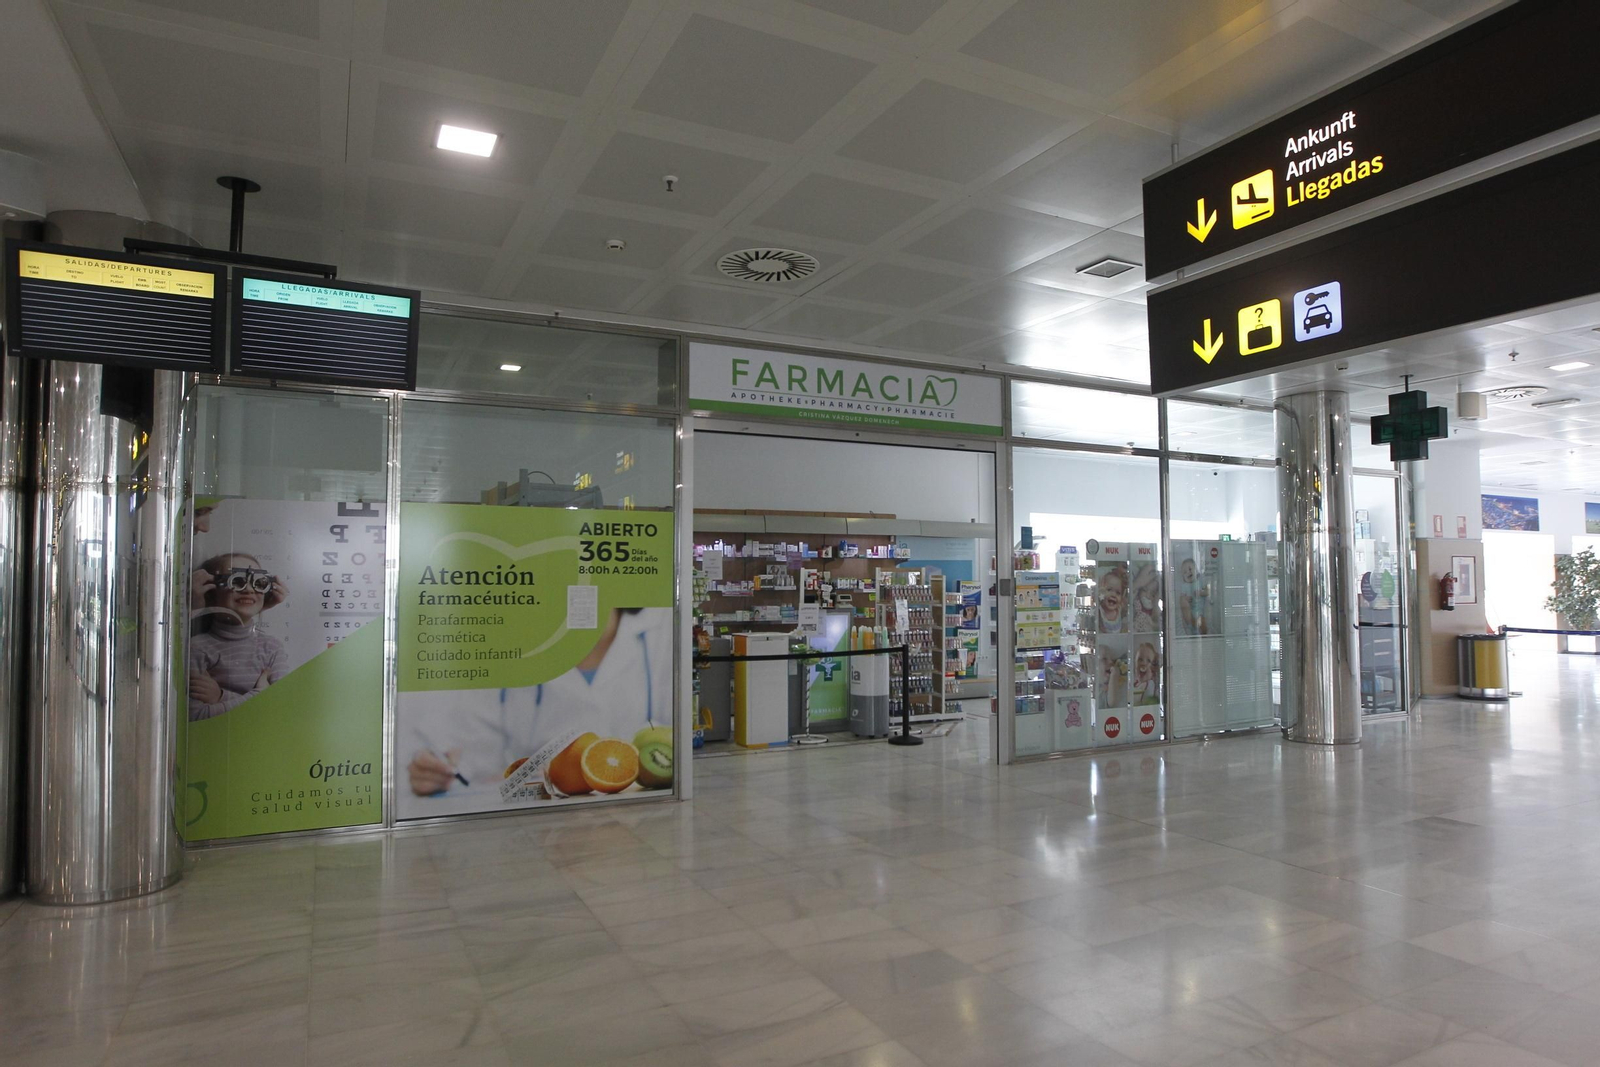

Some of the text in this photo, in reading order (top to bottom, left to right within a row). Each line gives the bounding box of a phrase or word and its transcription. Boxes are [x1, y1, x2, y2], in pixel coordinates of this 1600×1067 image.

[1285, 110, 1357, 158] Ankunft
[1286, 140, 1354, 181] Arrivals
[1286, 155, 1384, 207] Llegadas
[65, 259, 172, 276] SALIDAS/DEPARTURES
[281, 284, 376, 301] LLEGADAS/ARRIVALS
[732, 358, 940, 406] FARMACIA
[798, 411, 900, 425] CRISTINA VÁZQUEZ DOMENECH
[579, 522, 658, 537] ABIERTO
[579, 540, 630, 562] 365
[1138, 547, 1151, 555] NUK
[418, 563, 535, 586] Atención
[578, 565, 658, 575] 8:00h A 22:00h
[418, 590, 541, 606] farmacéutica.
[418, 613, 504, 626] Parafarmacia
[417, 630, 486, 643] Cosmética
[417, 647, 522, 661] Cuidado infantil
[417, 666, 489, 681] Fitoterapia
[1106, 723, 1119, 732] NUK
[1141, 720, 1153, 728] NUK
[309, 759, 372, 782] Óptica
[251, 785, 371, 802] Cuidamos tu
[251, 794, 371, 815] salud visual
